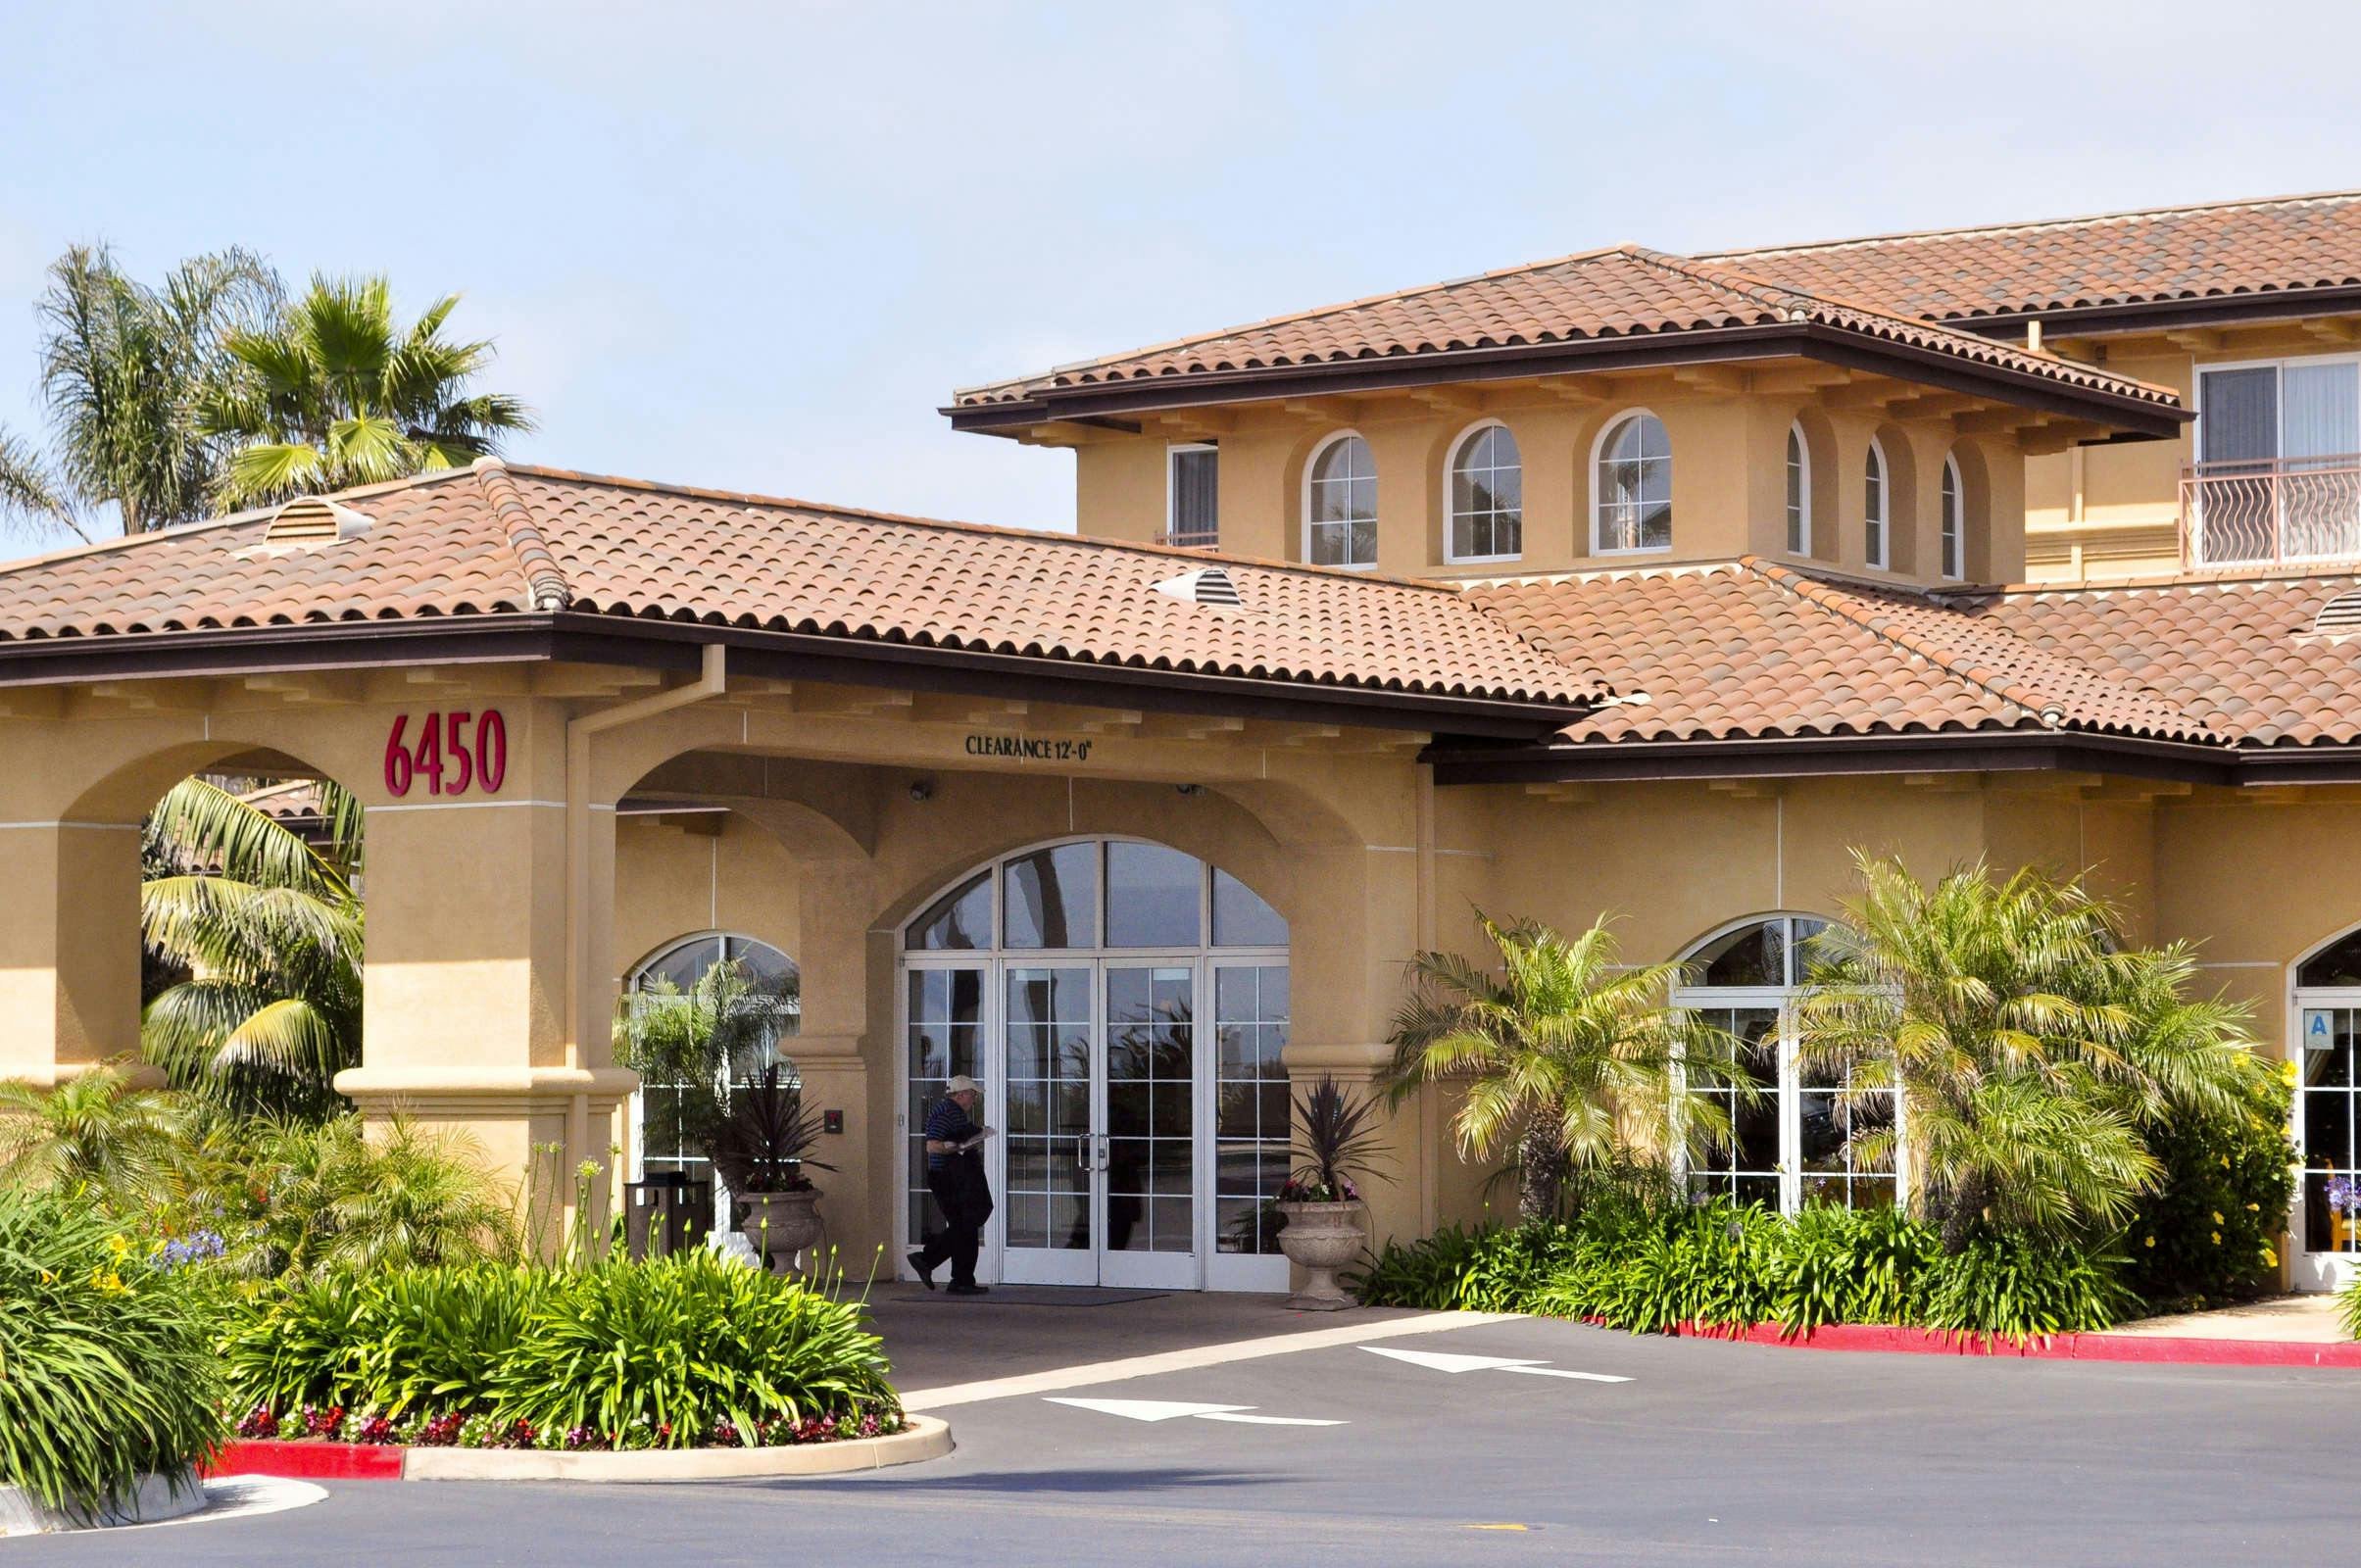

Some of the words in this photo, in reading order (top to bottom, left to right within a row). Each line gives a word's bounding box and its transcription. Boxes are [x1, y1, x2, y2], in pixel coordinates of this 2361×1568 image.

[384, 710, 507, 798] 6450
[965, 736, 1052, 760] CLEARANCE
[2311, 1014, 2328, 1035] A
